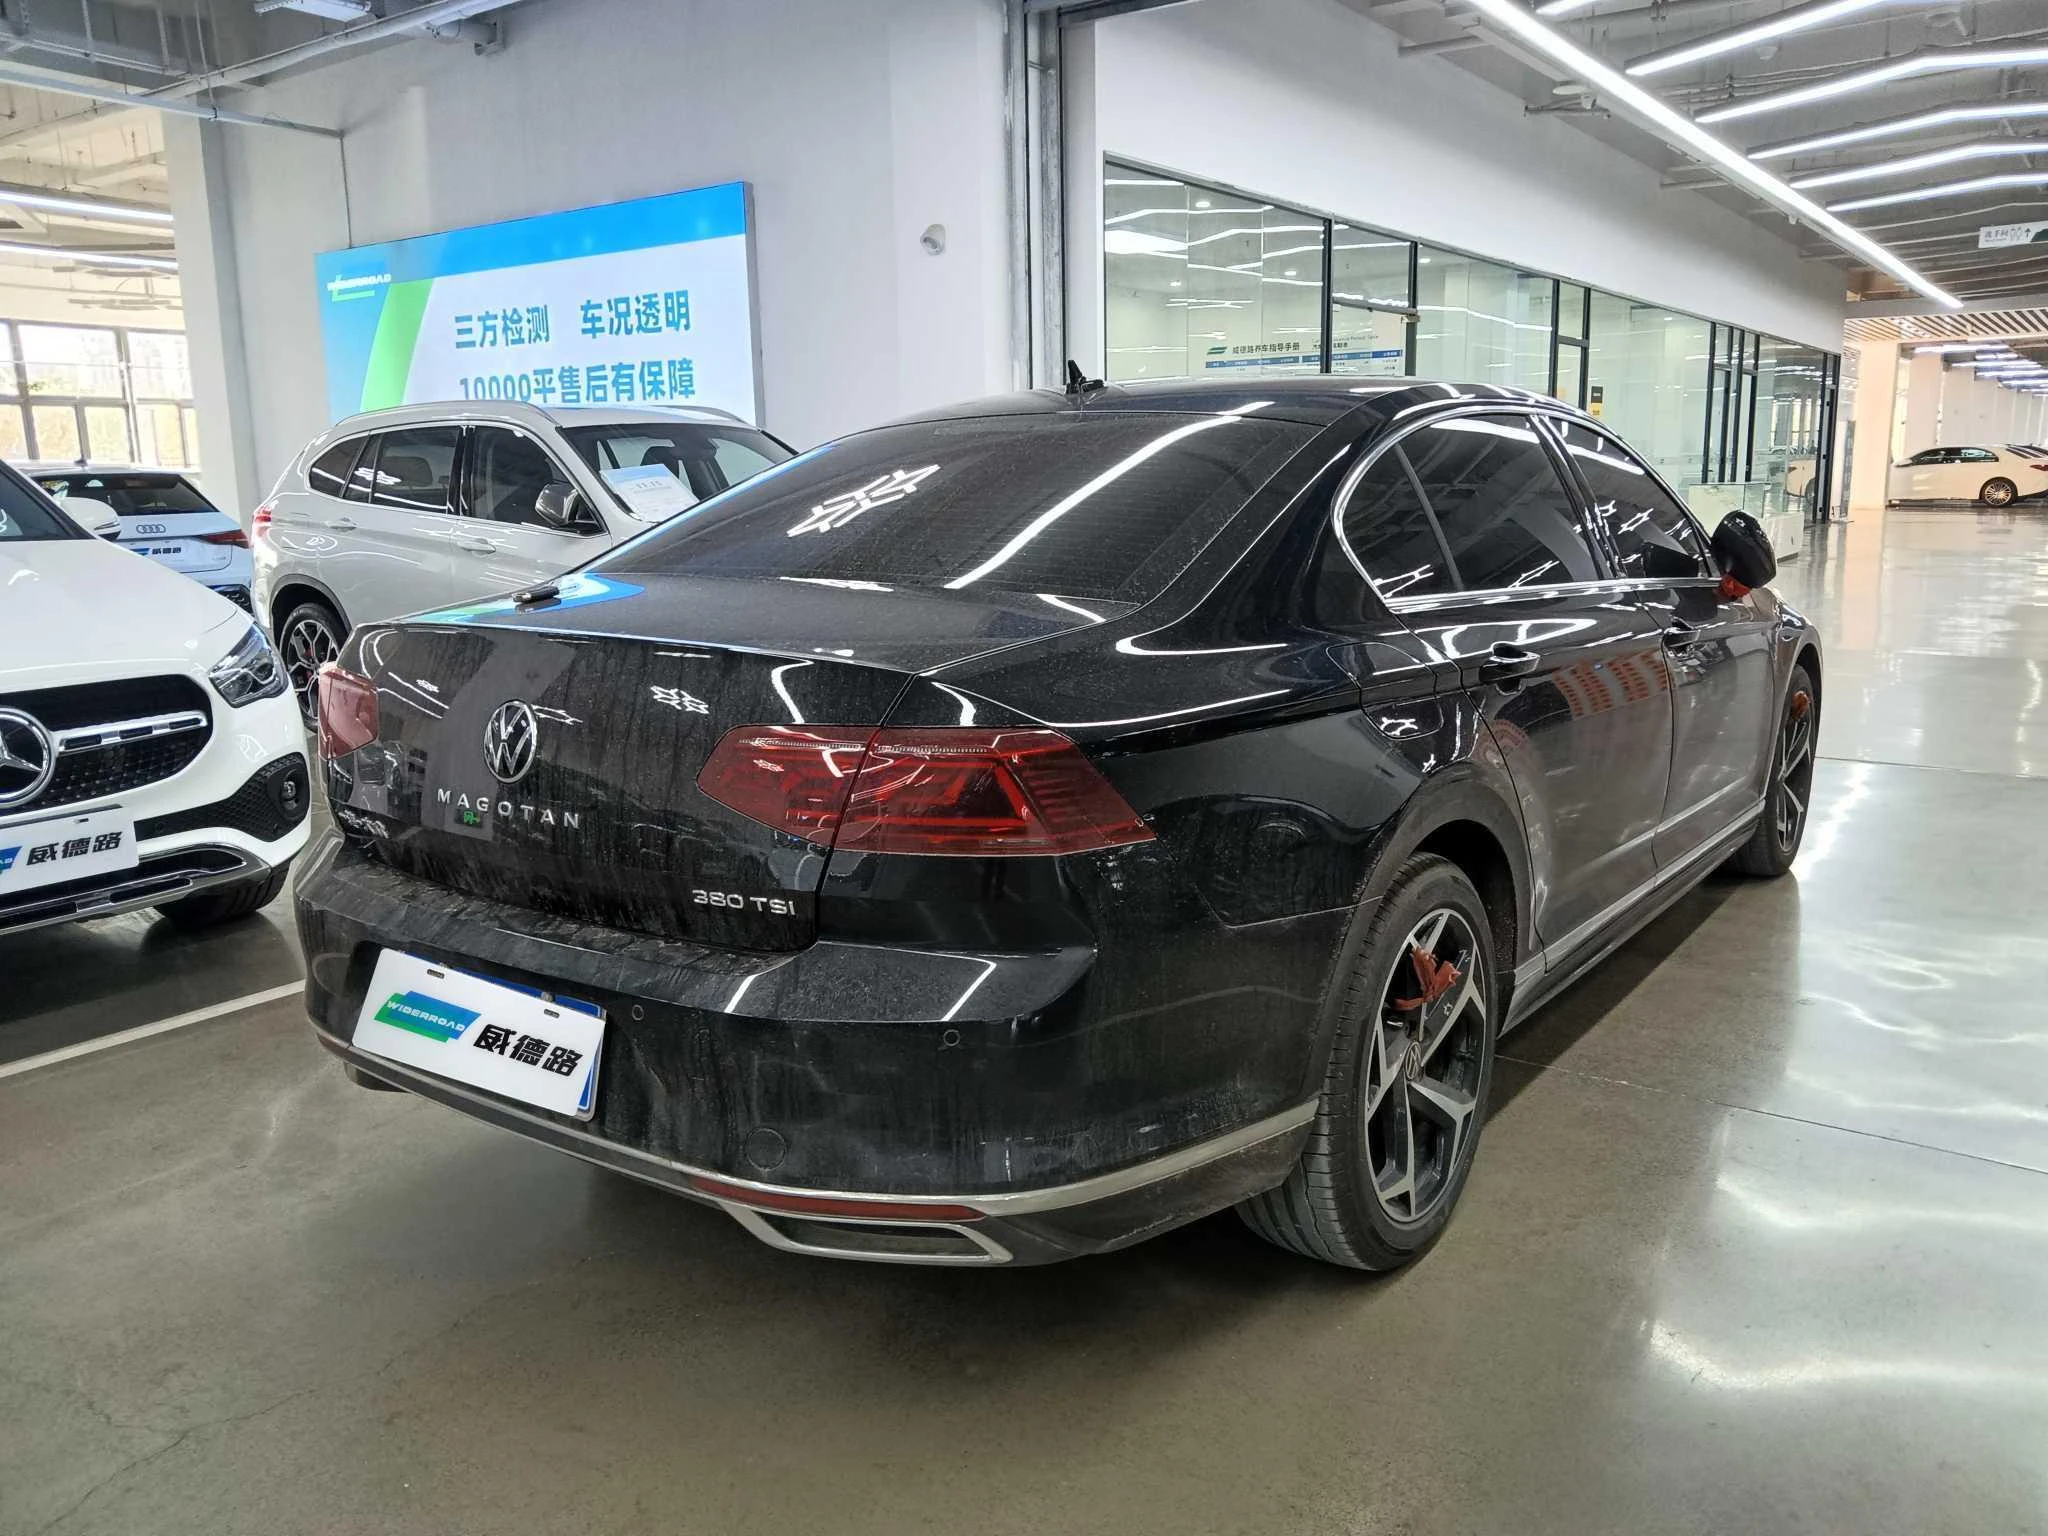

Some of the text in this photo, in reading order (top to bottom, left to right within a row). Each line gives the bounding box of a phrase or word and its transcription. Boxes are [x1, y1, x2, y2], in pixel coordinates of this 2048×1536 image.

[454, 289, 692, 350] 三方检测 车况透明
[459, 359, 696, 404] 10000平售后有保障
[437, 787, 581, 830] MAGOTAN
[26, 831, 123, 866] 威德路
[691, 889, 797, 916] 380 TSI
[386, 1000, 467, 1032] WIDERROAD
[472, 1023, 584, 1077] 威德路
